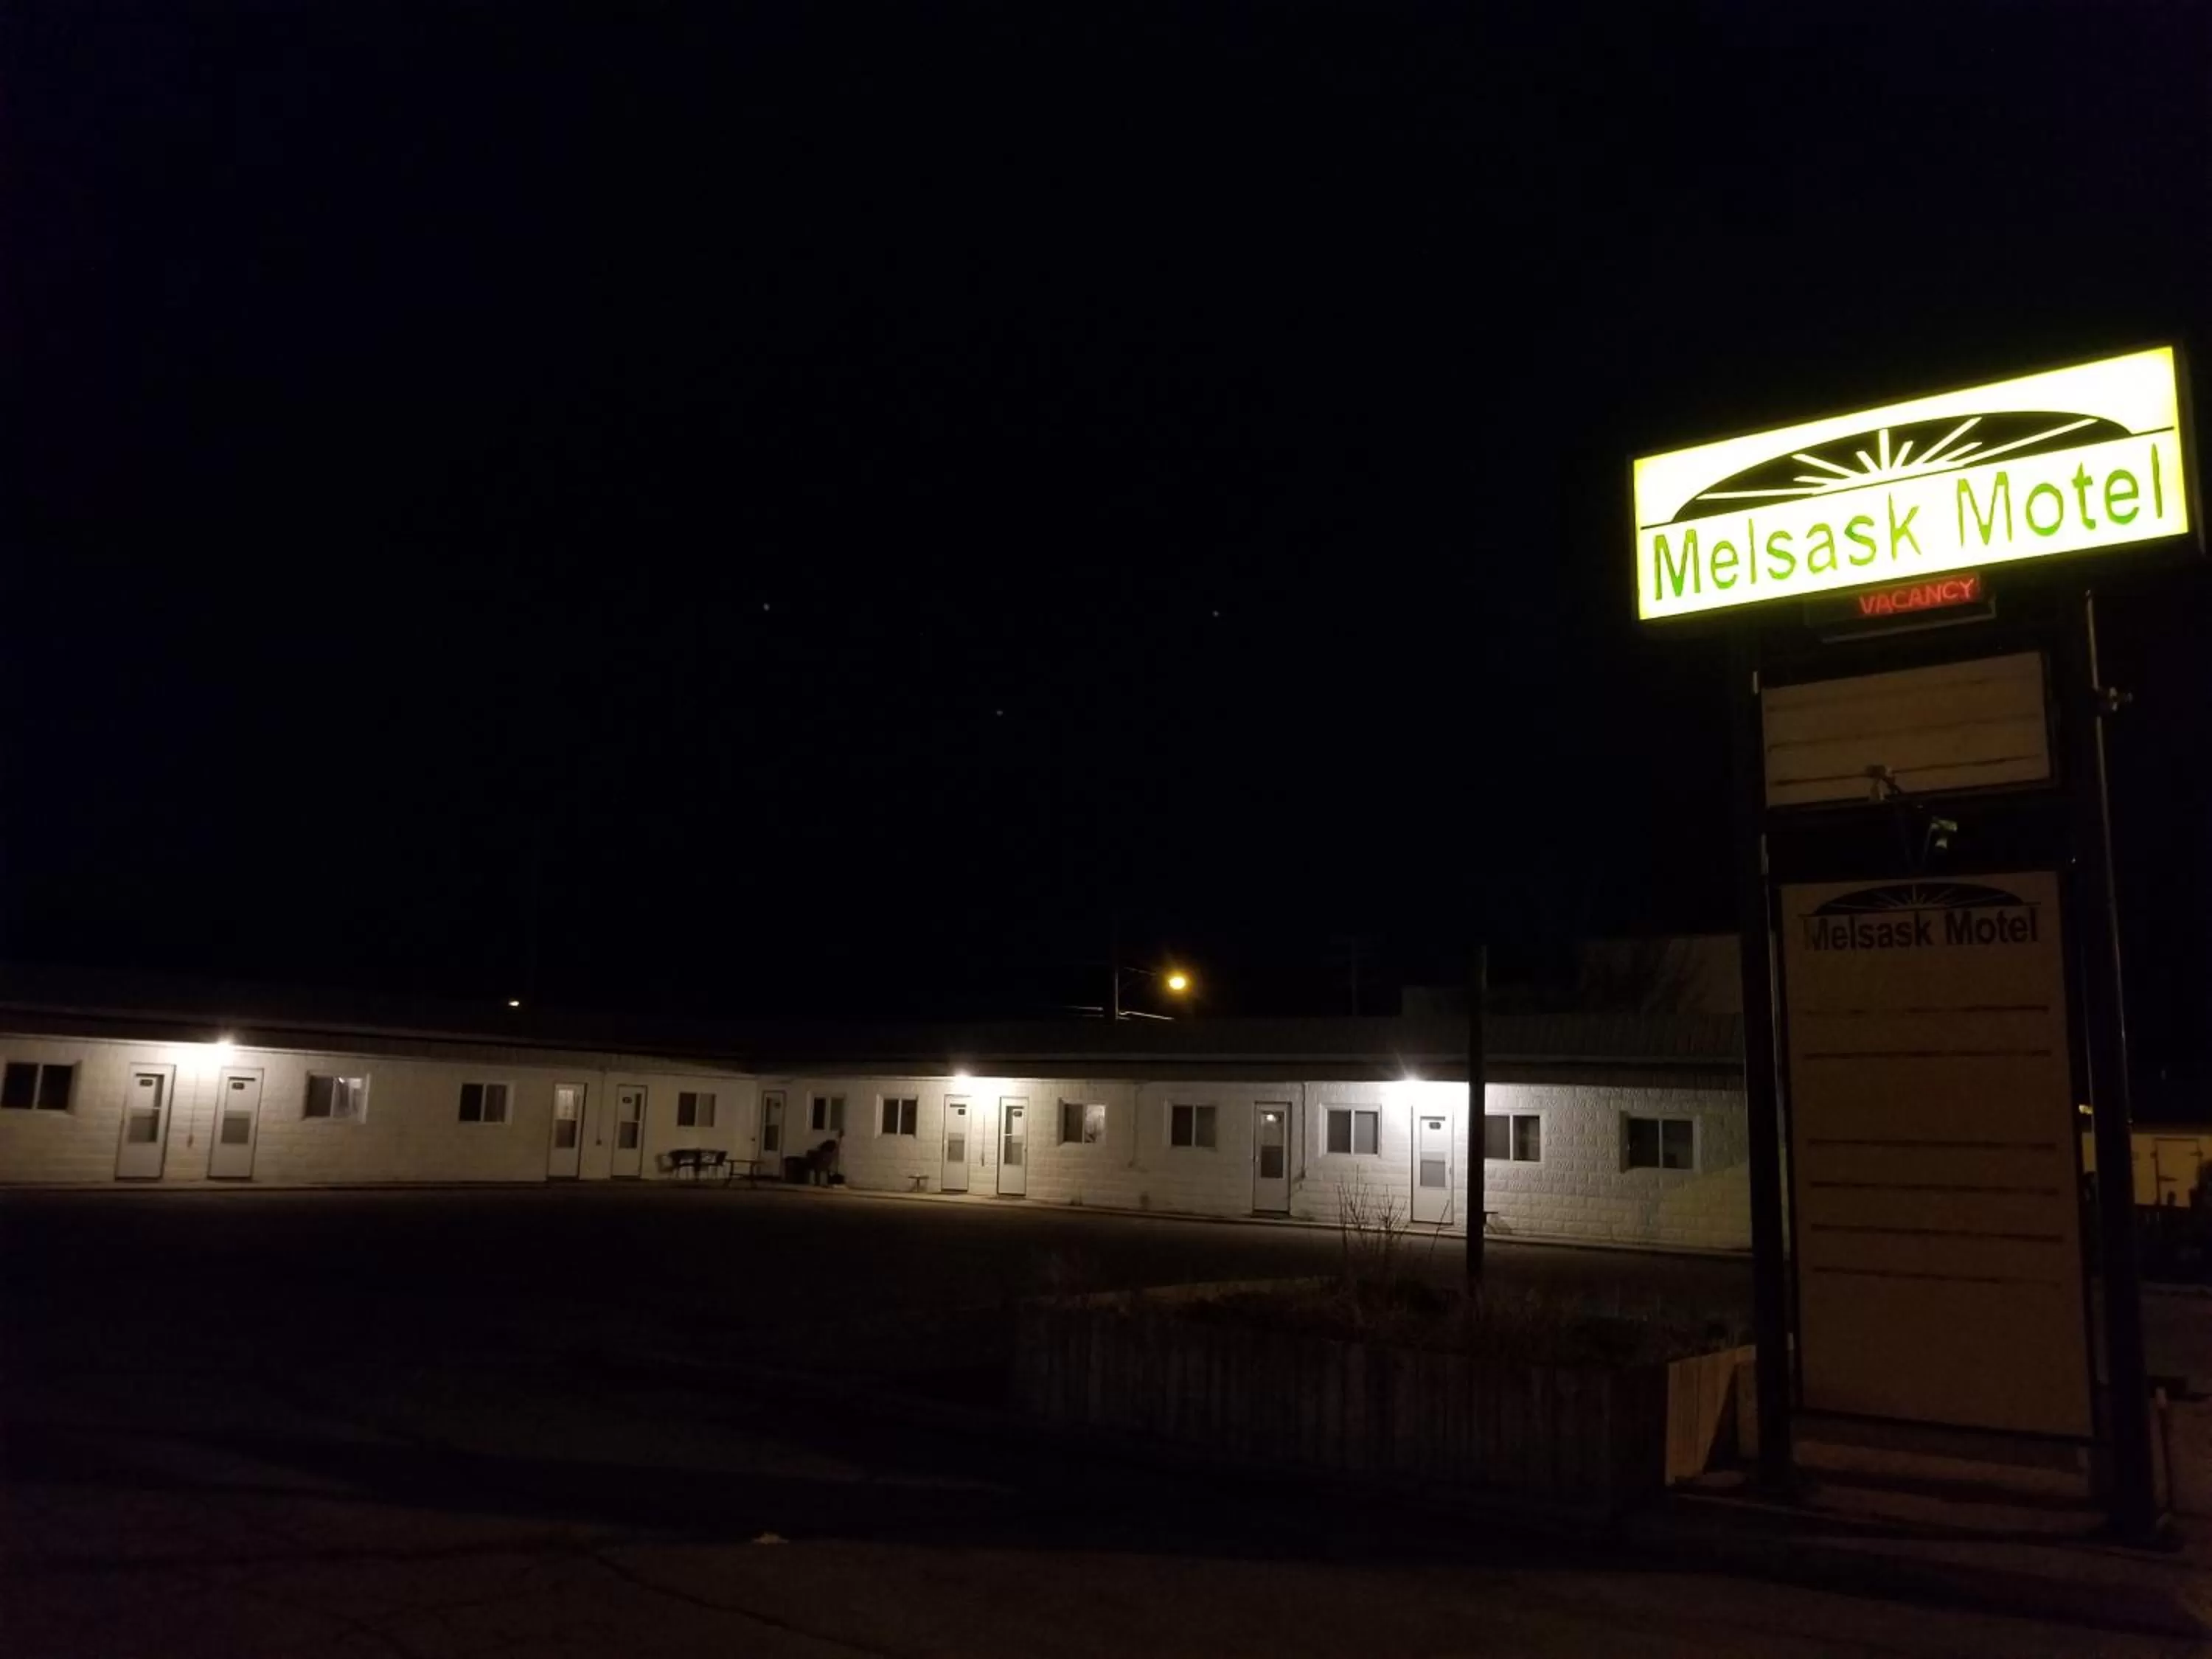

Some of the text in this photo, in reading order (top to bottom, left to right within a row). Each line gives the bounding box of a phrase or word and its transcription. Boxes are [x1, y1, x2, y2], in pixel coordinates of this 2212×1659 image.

[1654, 442, 2163, 601] Melsask Motel
[1859, 577, 1974, 613] VACANCY
[1803, 907, 2038, 950] Melsask Motel
